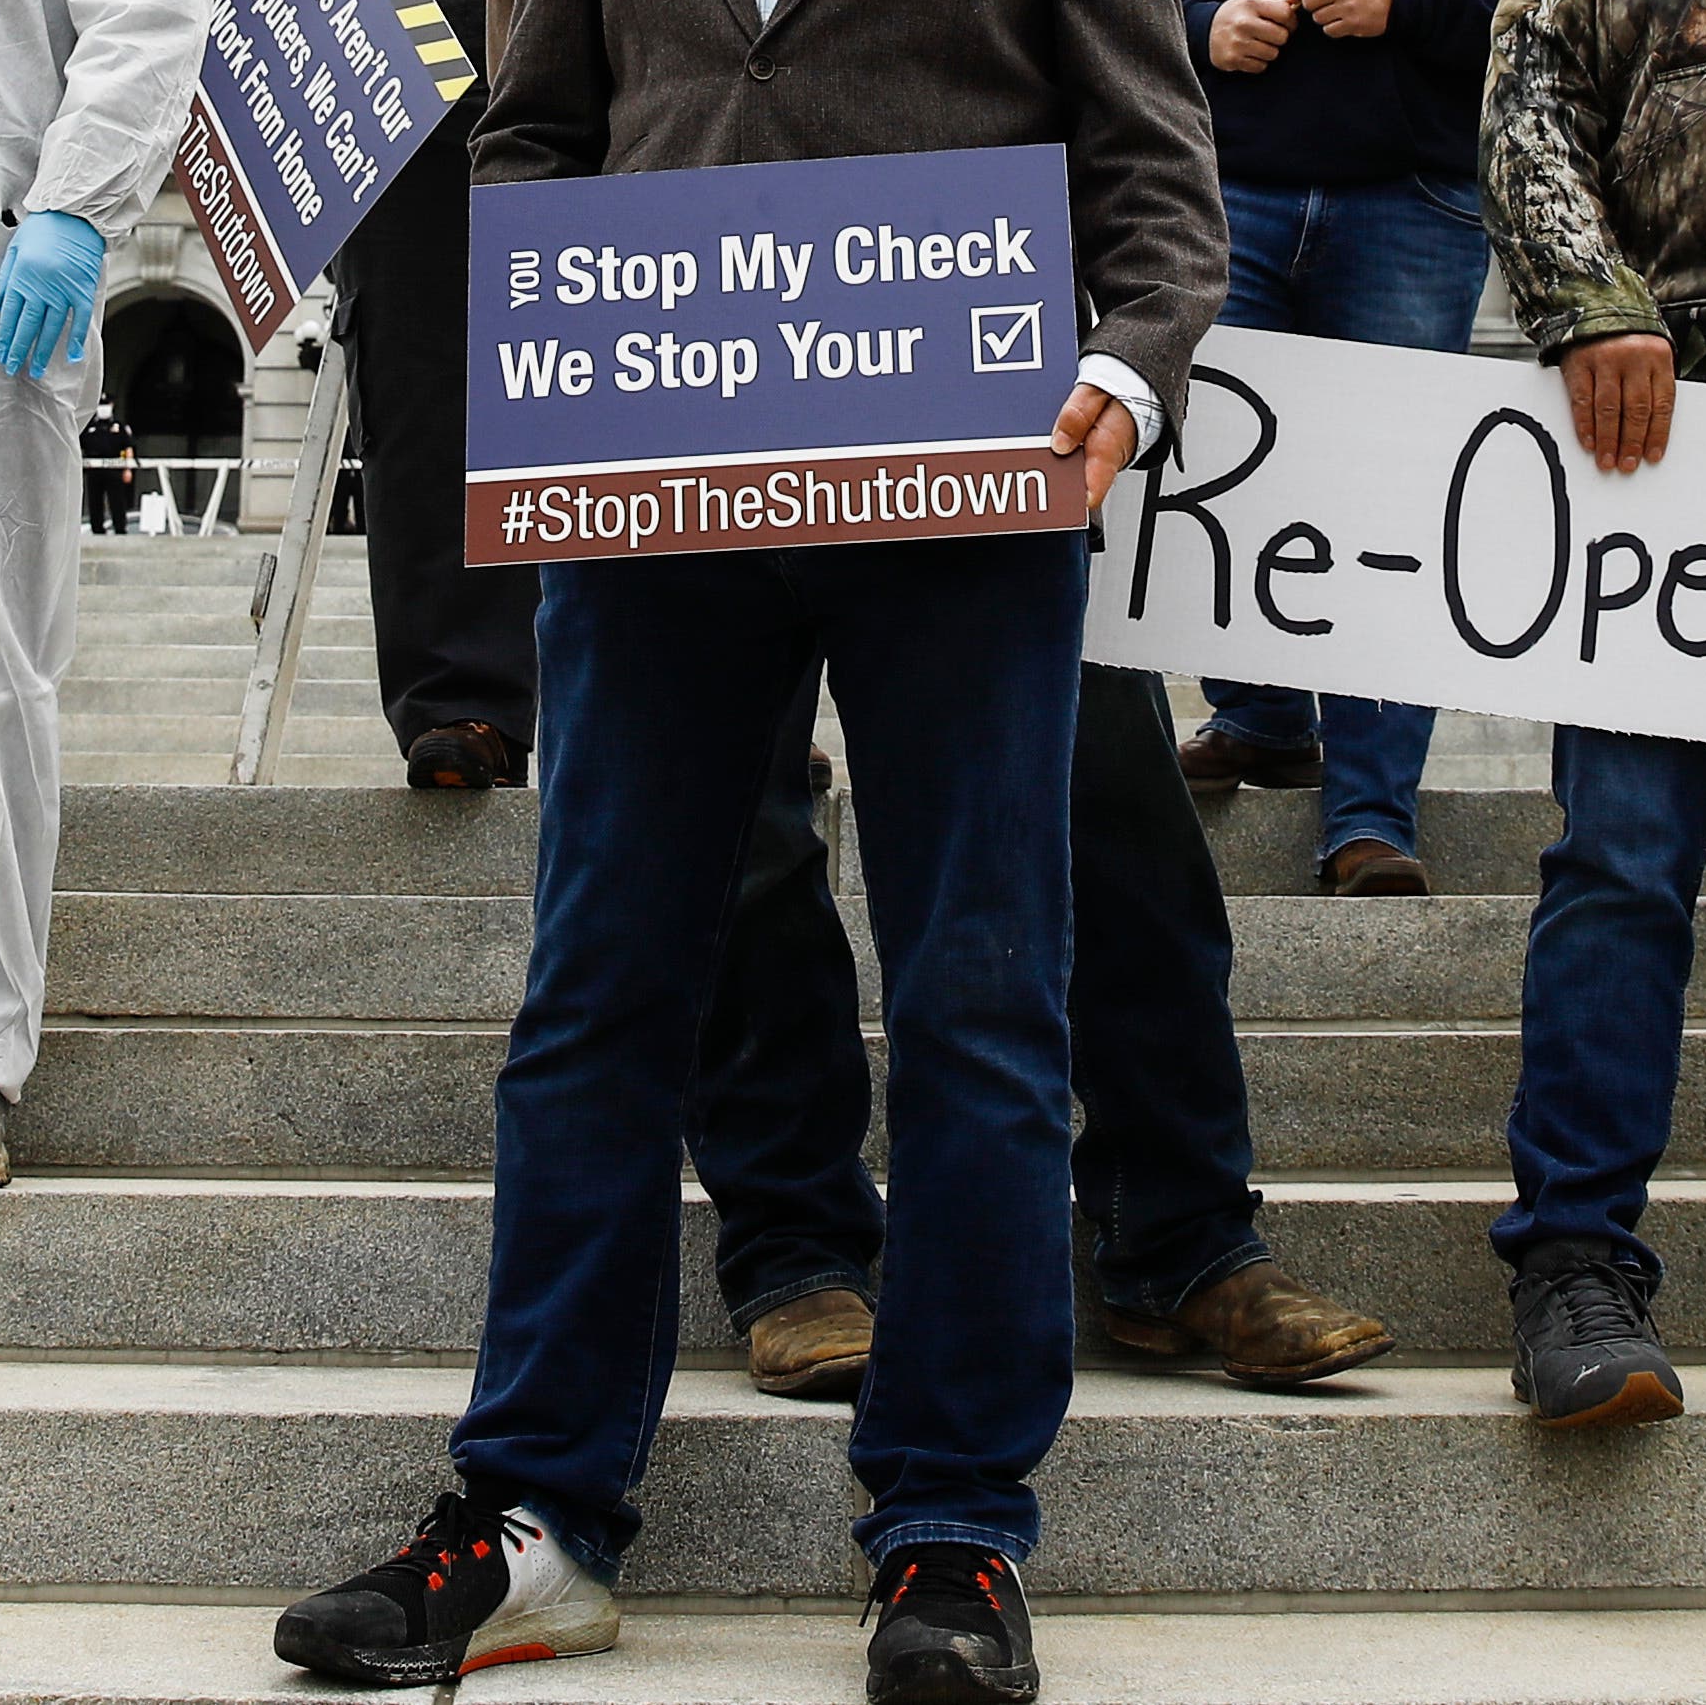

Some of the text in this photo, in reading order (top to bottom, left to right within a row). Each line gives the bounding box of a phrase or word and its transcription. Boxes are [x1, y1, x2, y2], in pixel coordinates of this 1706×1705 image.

[240, 59, 286, 148] From
[273, 128, 324, 226] Home
[303, 61, 337, 126] We
[325, 110, 380, 203] Can't
[372, 77, 413, 143] Our
[508, 217, 1037, 311] YOU Stop My Check
[497, 319, 924, 401] We Stop Your
[500, 463, 1048, 550] #StopTheShutdown
